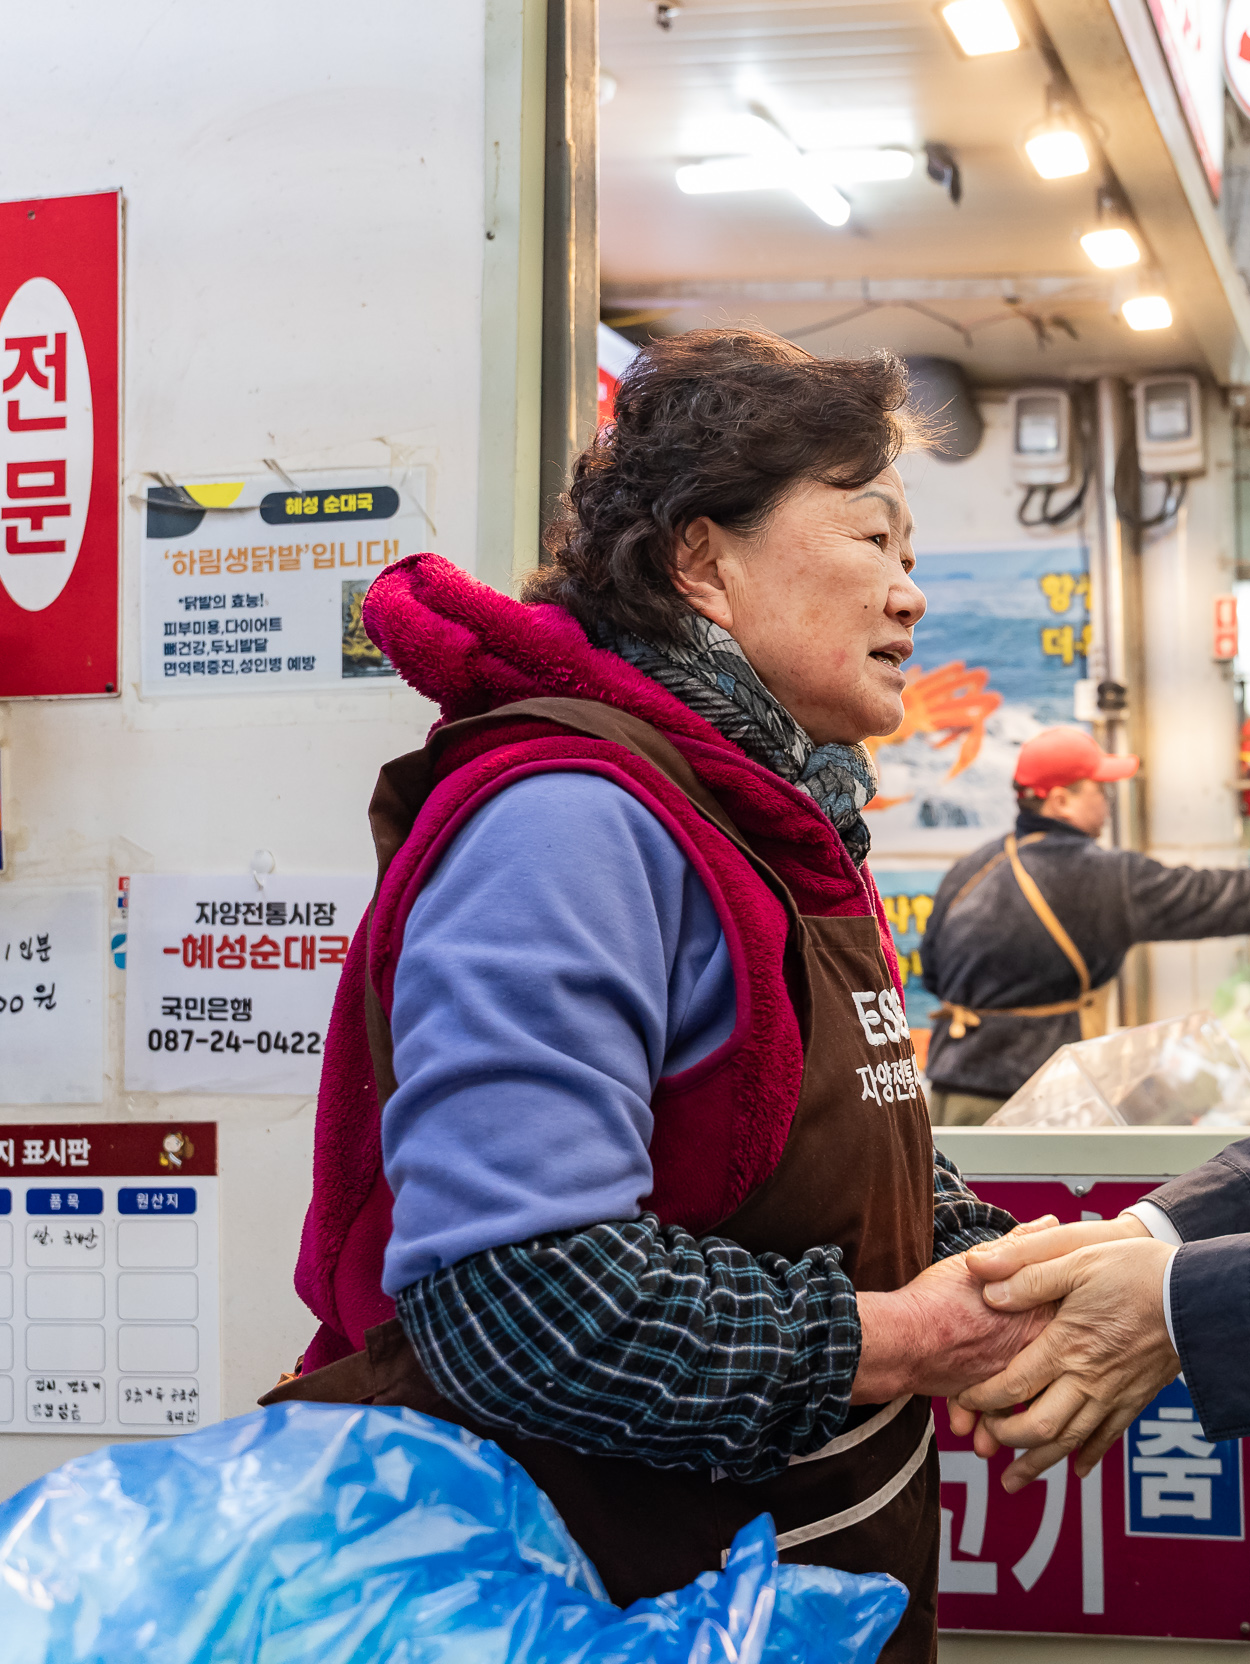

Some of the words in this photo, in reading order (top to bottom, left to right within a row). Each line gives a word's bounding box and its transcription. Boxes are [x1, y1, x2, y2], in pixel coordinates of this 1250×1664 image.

[1, 332, 71, 555] 전문
[286, 497, 318, 515] 혜성
[324, 493, 373, 514] 순대국
[231, 593, 264, 609] 효능!
[164, 617, 283, 636] 피부미용,다이어트
[164, 638, 268, 656] 뼈건강,두뇌발달
[164, 658, 283, 677] 면역력증진,성인병
[287, 656, 316, 671] 예방
[196, 902, 337, 926] 자양전통시장
[20, 933, 51, 962] 인분
[163, 934, 350, 971] -혜성순대국
[33, 982, 57, 1010] 원
[161, 997, 252, 1022] 국민은행
[148, 1029, 325, 1054] 087-24-0422
[22, 1138, 91, 1167] 표시판
[136, 1192, 179, 1209] 원산지
[1132, 1407, 1222, 1520] 춤
[938, 1449, 1104, 1615] 고기
